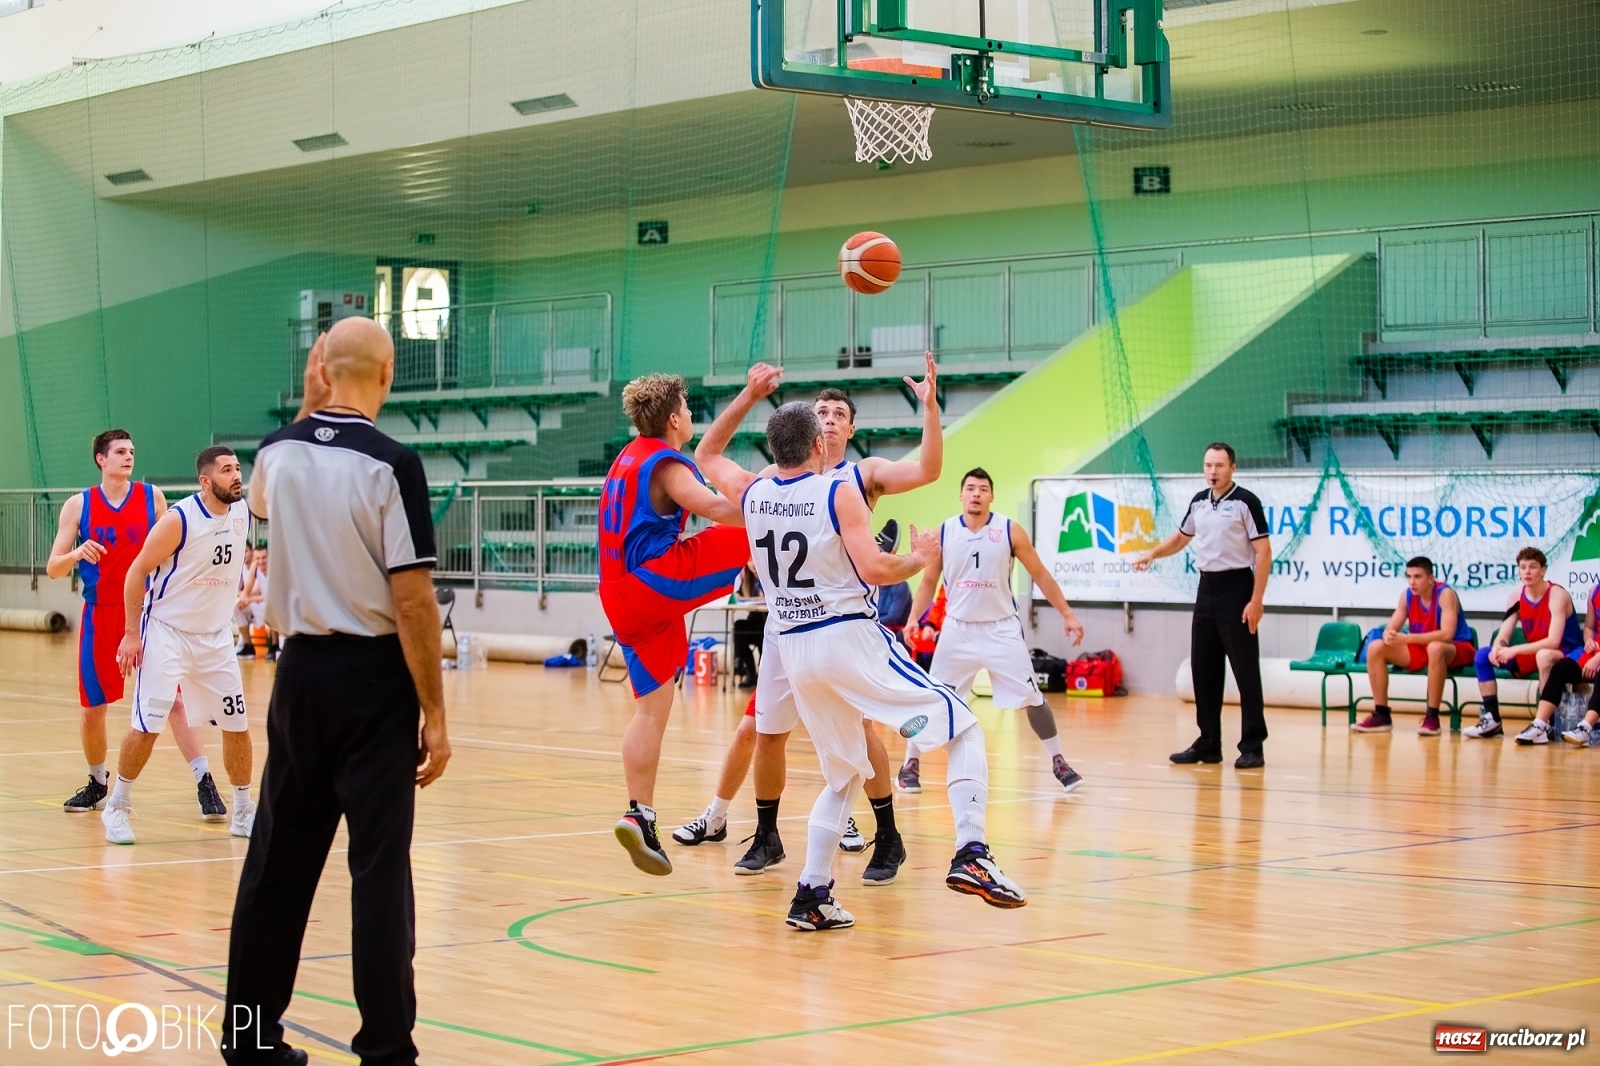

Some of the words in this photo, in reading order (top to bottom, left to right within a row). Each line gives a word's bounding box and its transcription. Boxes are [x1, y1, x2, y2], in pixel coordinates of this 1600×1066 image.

[1143, 176, 1161, 190] B
[642, 229, 661, 241] A
[760, 501, 815, 517] ATŁACHOWICZ
[1329, 506, 1547, 537] RACIBORSKI
[94, 526, 117, 547] 24
[212, 544, 233, 566] 35
[755, 529, 816, 588] 12
[972, 551, 980, 569] 1
[1054, 560, 1095, 576] powiat
[1569, 571, 1600, 588] pow
[696, 653, 708, 678] 5
[222, 694, 246, 716] 35
